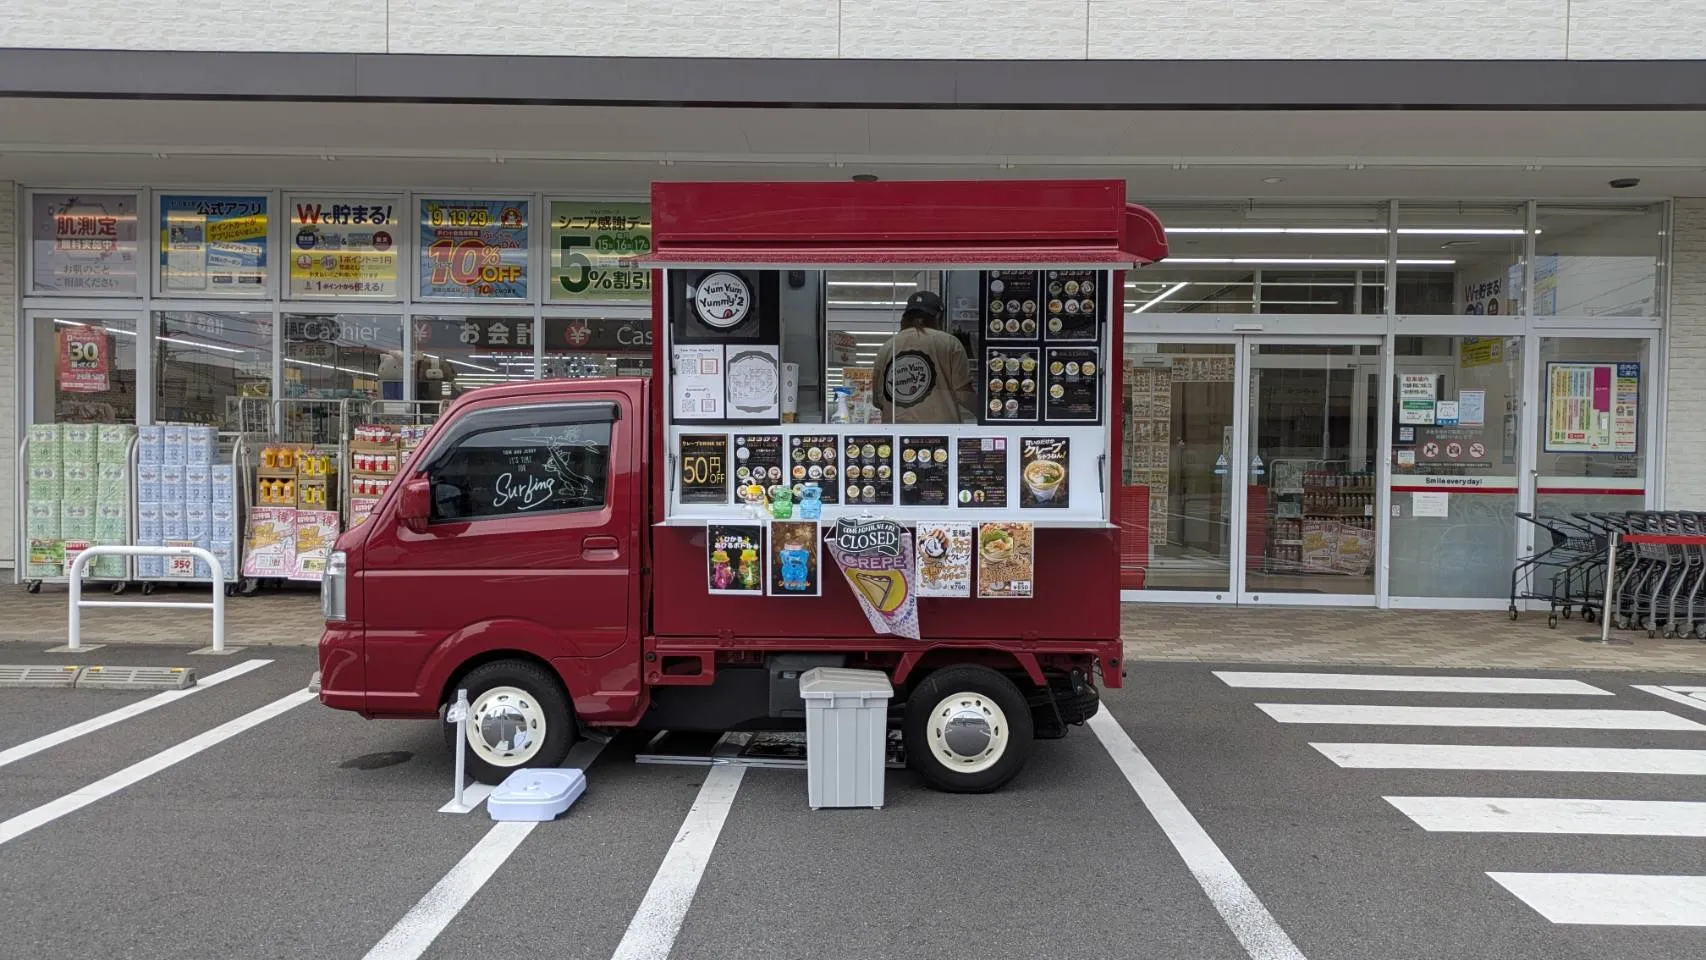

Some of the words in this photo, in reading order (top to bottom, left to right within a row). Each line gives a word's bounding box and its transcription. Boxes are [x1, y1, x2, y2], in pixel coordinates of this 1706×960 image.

[196, 202, 261, 216] 公式アプリ
[57, 217, 117, 236] 肌測定
[560, 215, 650, 231] シニア感謝デー
[480, 266, 523, 284] OFF
[704, 285, 723, 295] Yum
[724, 283, 742, 295] Yum
[303, 315, 380, 341] Cashier
[710, 474, 725, 484] OFF
[493, 472, 555, 510] Surfing
[840, 531, 895, 549] CLOSED
[839, 552, 907, 570] CREPE
